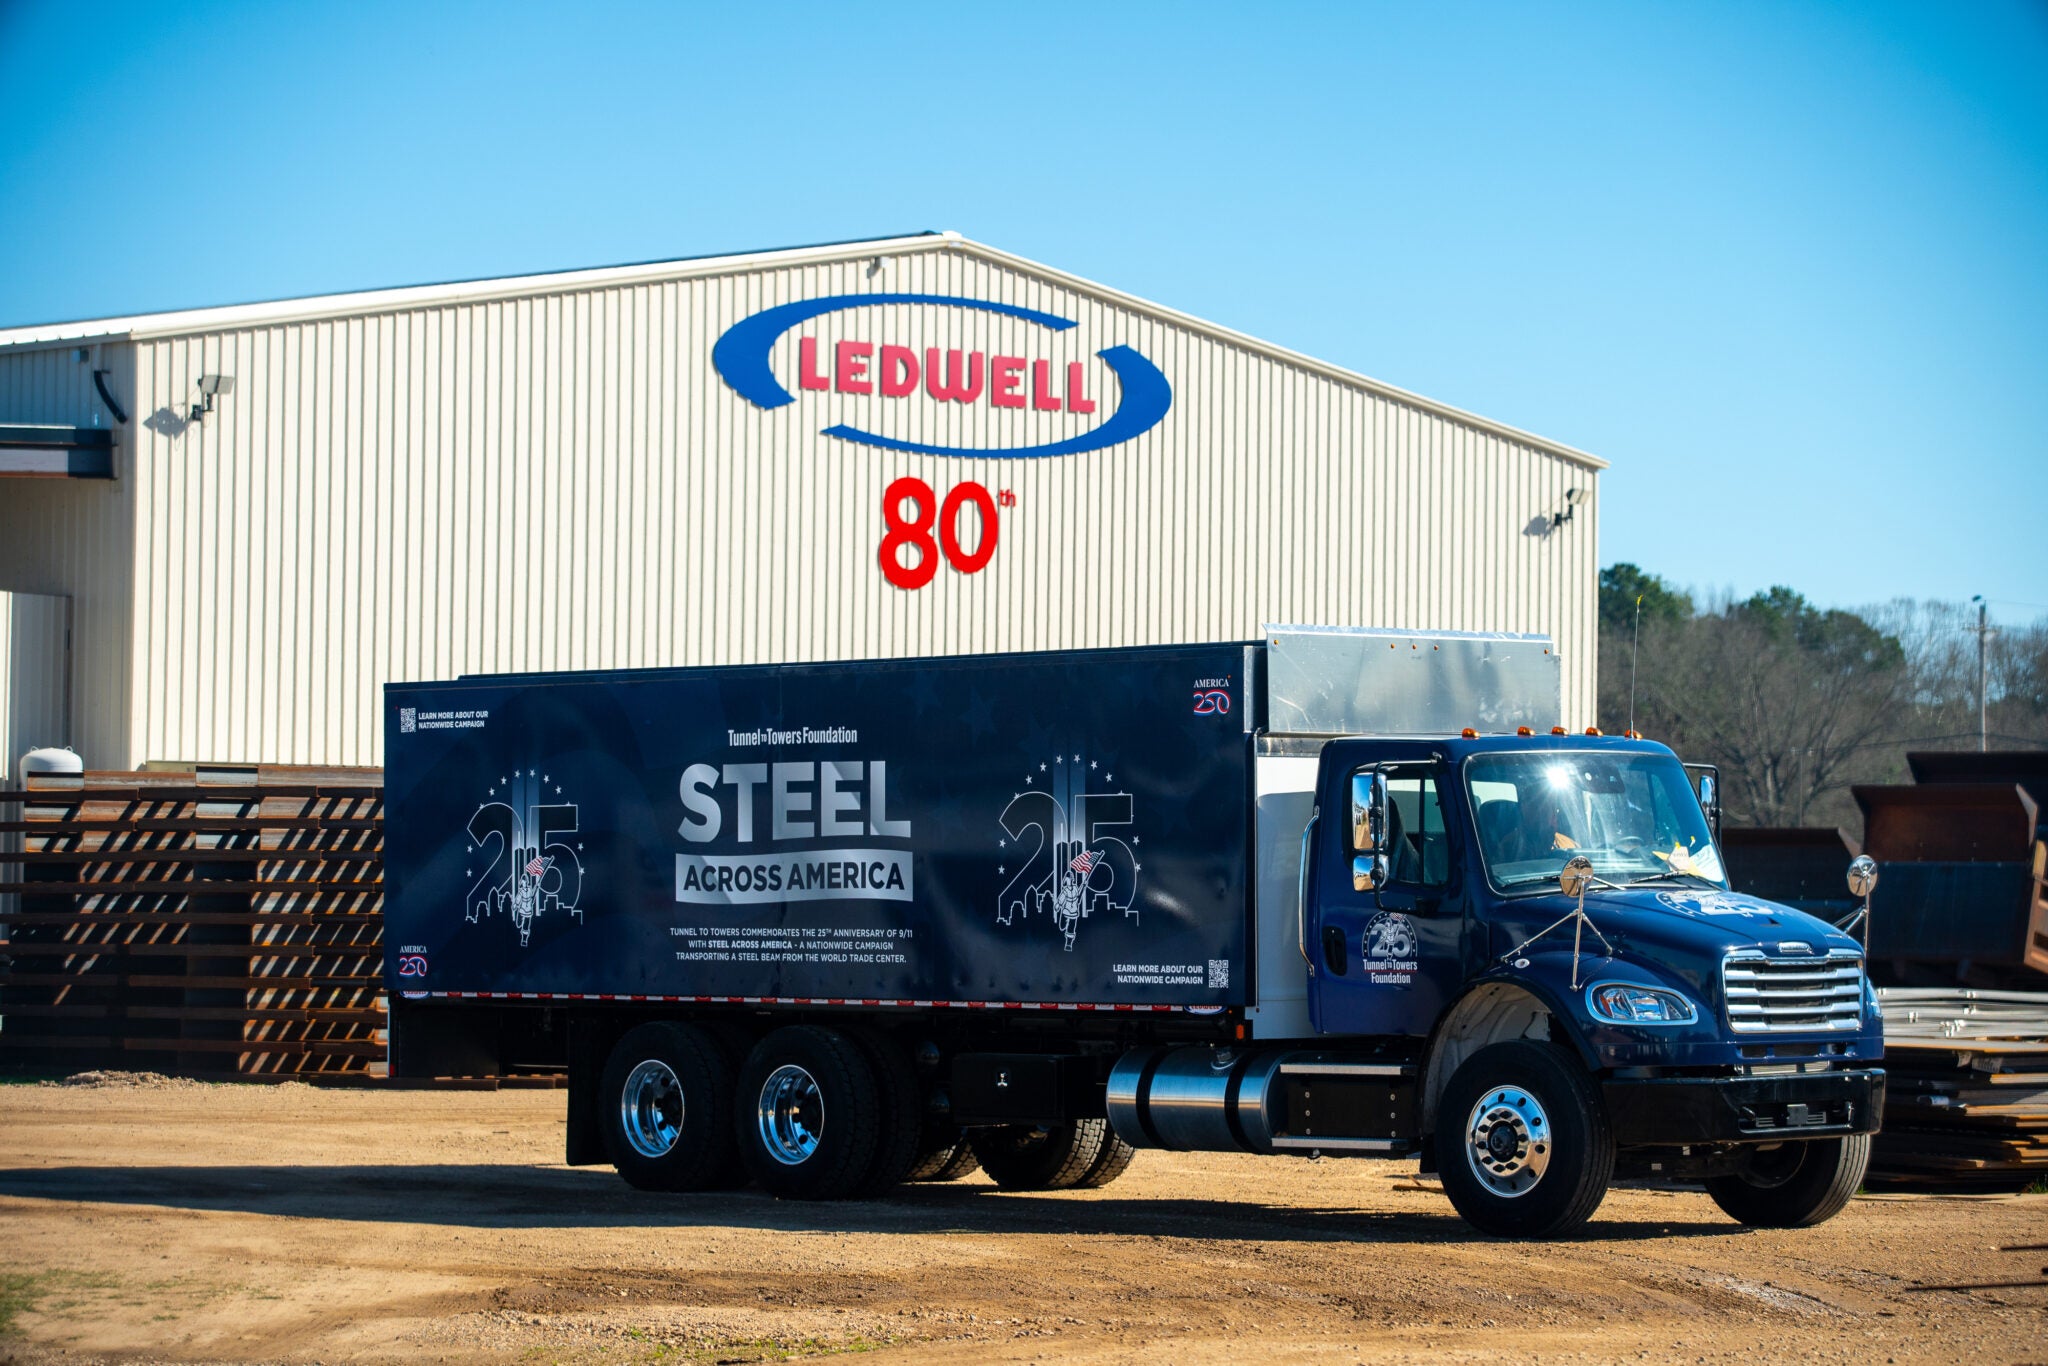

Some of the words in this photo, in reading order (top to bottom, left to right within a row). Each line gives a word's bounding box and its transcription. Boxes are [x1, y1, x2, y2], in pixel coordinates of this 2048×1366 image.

[800, 336, 1096, 413] LEDWELL
[879, 476, 1016, 590] 80th
[1193, 678, 1229, 688] AMERICA
[1193, 688, 1231, 716] 250
[418, 712, 437, 720] LEARN
[437, 712, 454, 720] MORE
[454, 711, 475, 719] ABOUT
[475, 710, 489, 718] OUR
[418, 721, 454, 730] NATIONWIDE
[454, 720, 485, 728] CAMPAIGN
[727, 728, 761, 746] Tunnel
[766, 728, 802, 745] Towers
[802, 726, 858, 744] Foundation
[677, 760, 911, 843] STEEL
[683, 864, 783, 892] ACROSS
[786, 861, 905, 891] AMERICA
[670, 927, 698, 936] TUNNEL
[699, 927, 709, 936] TO
[710, 928, 740, 936] TOWERS
[741, 928, 800, 937] COMMEMORATES
[802, 928, 816, 937] THE
[833, 929, 885, 938] ANNIVERSARY
[886, 929, 898, 938] OF
[899, 929, 913, 939] 9/11
[400, 945, 427, 953] AMERICA
[688, 940, 707, 948] WITH
[708, 940, 730, 948] STEEL
[731, 940, 759, 949] ACROSS
[760, 941, 793, 949] AMERICA
[799, 941, 805, 949] A
[806, 941, 853, 949] NATIONWIDE
[855, 941, 894, 950] CAMPAIGN
[676, 952, 729, 960] TRANSPORTING
[731, 952, 737, 960] A
[738, 953, 760, 961] STEEL
[761, 953, 781, 961] BEAM
[782, 953, 803, 961] FROM
[805, 953, 819, 962] THE
[820, 954, 847, 962] WORLD
[849, 954, 874, 962] TRADE
[875, 954, 907, 963] CENTER.
[399, 954, 428, 977] 250
[1113, 964, 1137, 973] LEARN
[1138, 964, 1159, 973] MORE
[1160, 965, 1185, 974] ABOUT
[1187, 965, 1203, 974] OUR
[1362, 959, 1387, 970] Tunnel
[1392, 959, 1418, 970] Towers
[1117, 975, 1164, 984] NATIONWIDE
[1165, 976, 1203, 985] CAMPAIGN
[1371, 972, 1411, 984] Foundation
